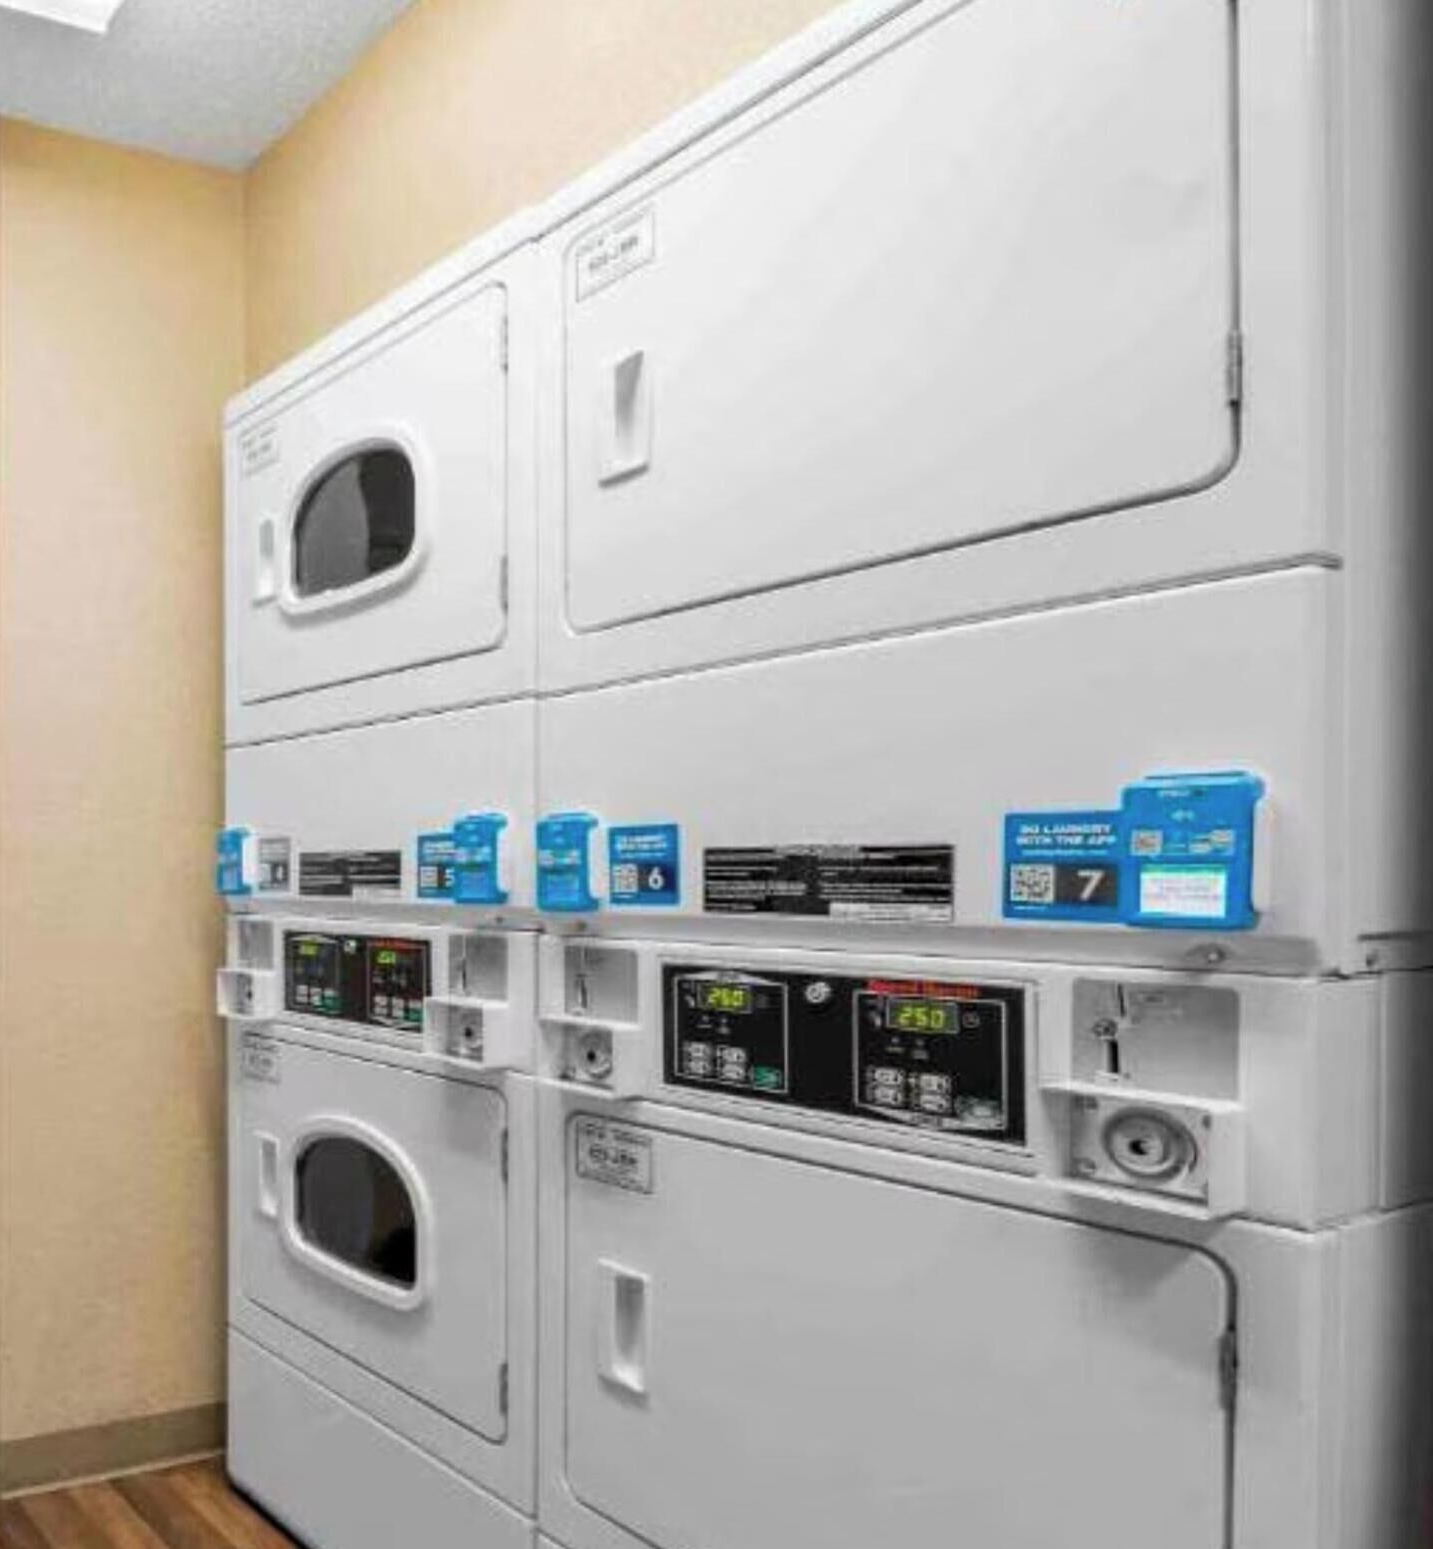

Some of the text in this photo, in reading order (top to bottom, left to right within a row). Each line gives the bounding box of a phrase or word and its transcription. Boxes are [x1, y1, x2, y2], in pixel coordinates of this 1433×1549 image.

[1055, 835, 1083, 846] THE
[647, 866, 664, 890] 6
[1077, 869, 1104, 901] 7
[898, 1006, 944, 1029] 250
